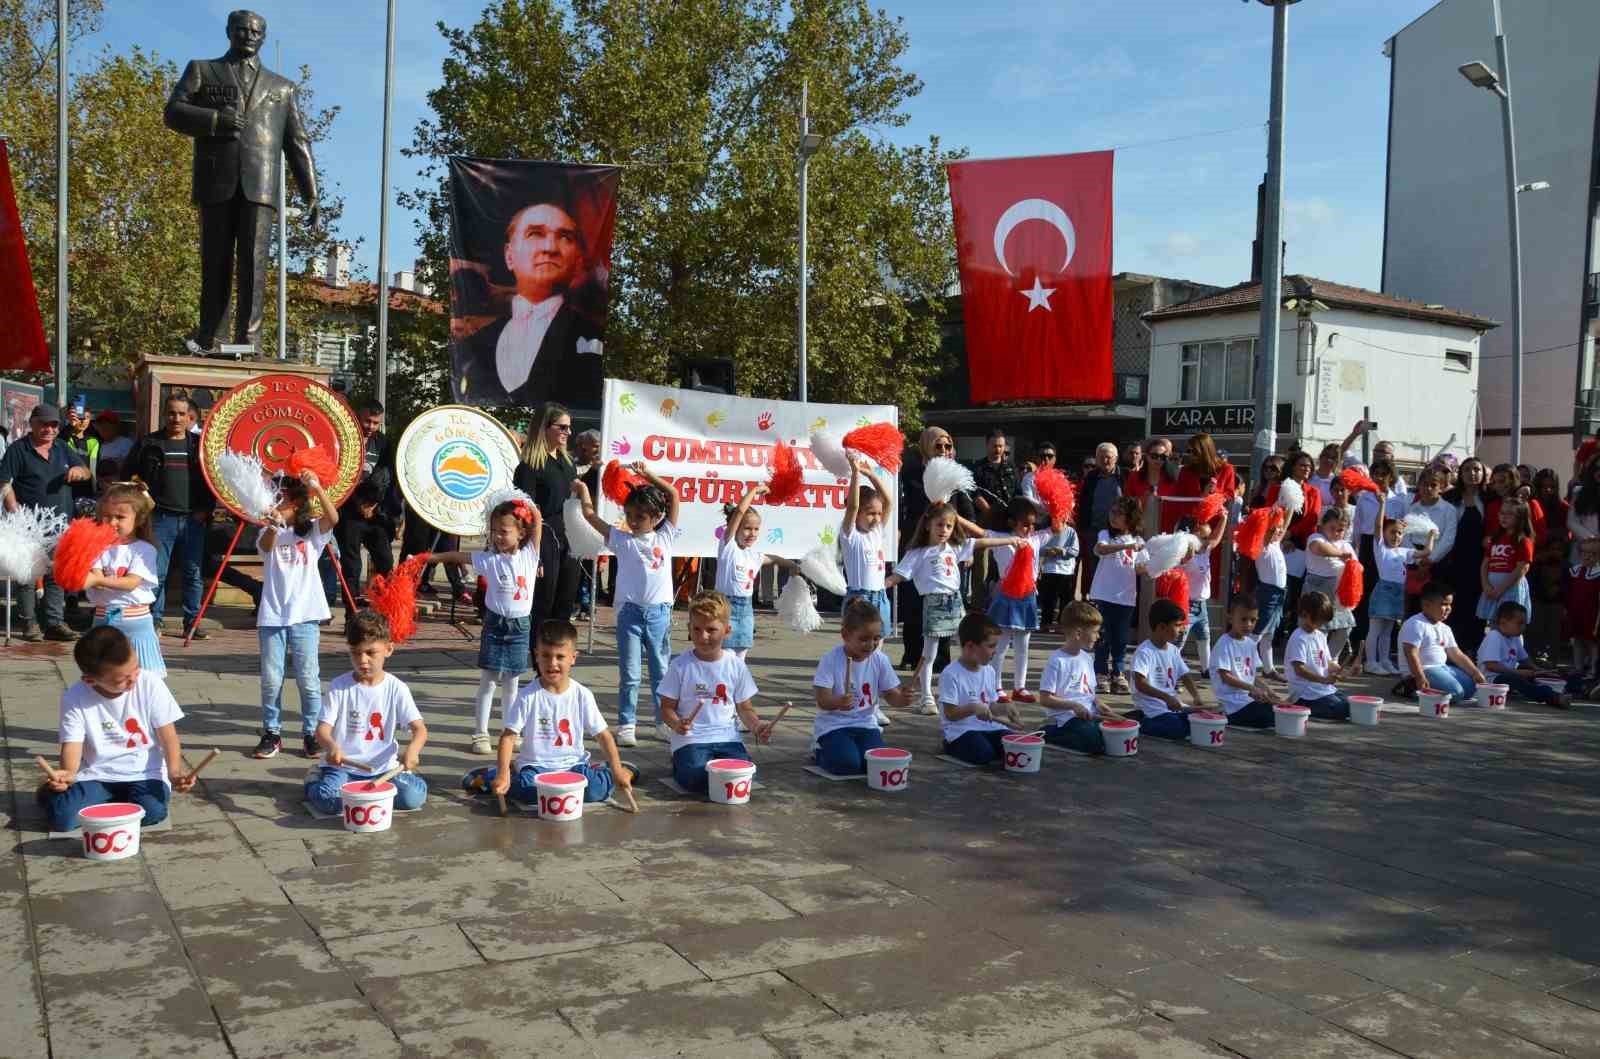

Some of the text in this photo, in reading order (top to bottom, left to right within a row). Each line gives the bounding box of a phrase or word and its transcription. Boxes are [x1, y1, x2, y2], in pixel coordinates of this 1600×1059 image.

[1165, 407, 1256, 426] KARA FIR
[643, 435, 826, 470] CUMHUY
